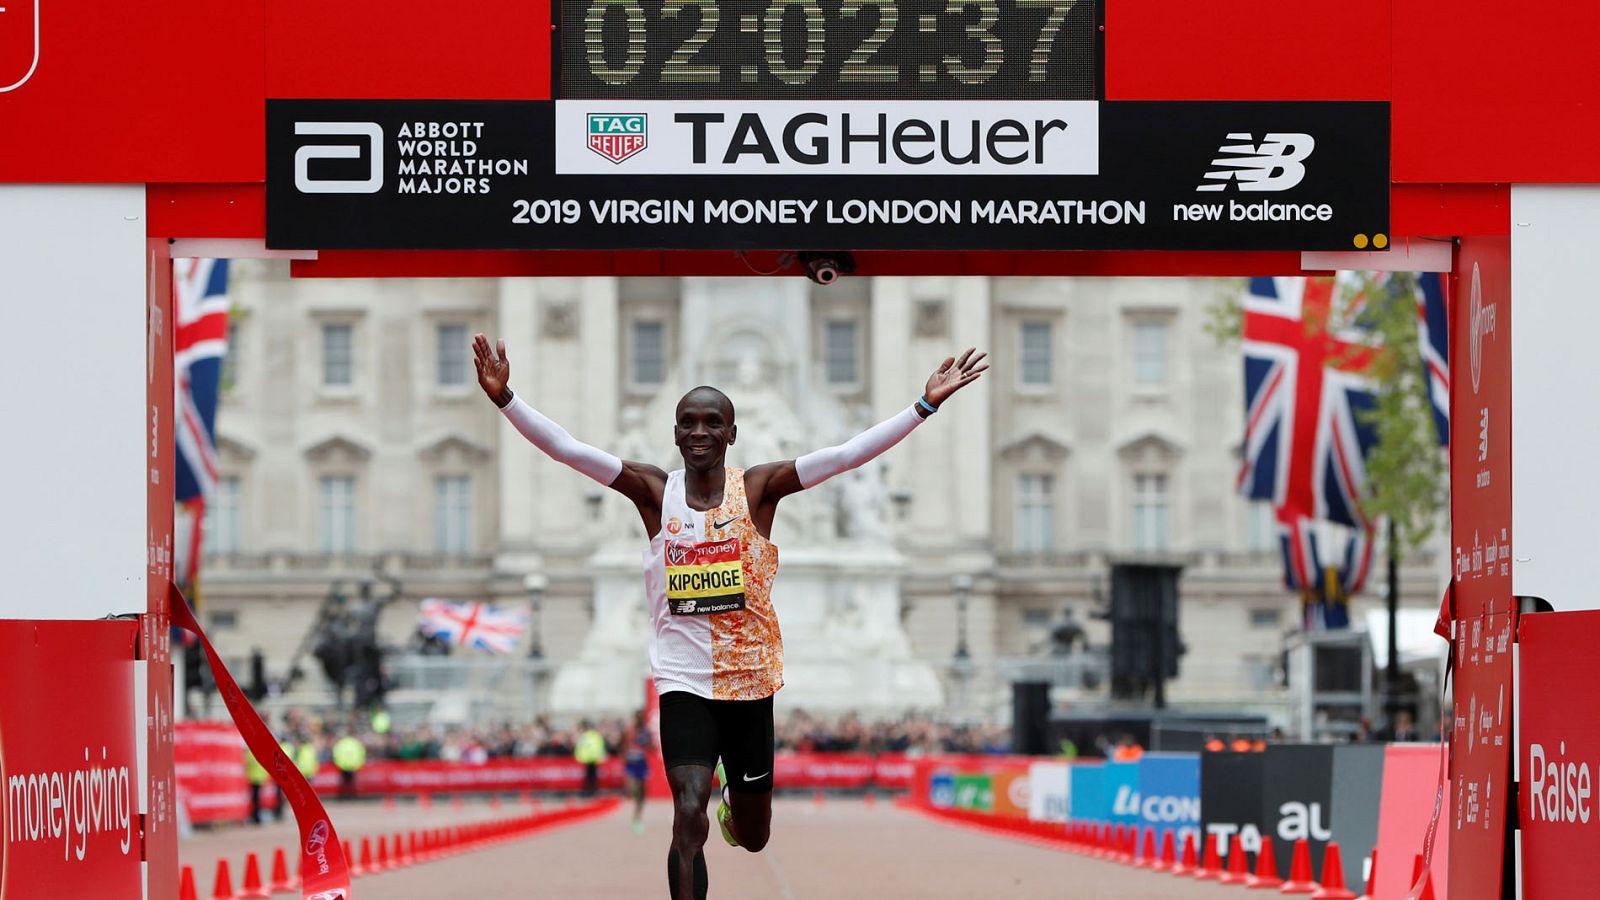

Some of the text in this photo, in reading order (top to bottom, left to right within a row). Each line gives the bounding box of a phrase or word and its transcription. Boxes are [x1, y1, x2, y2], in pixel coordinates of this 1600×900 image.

[585, 0, 1076, 84] 02:02:37
[398, 122, 485, 139] ABBOTT
[593, 118, 641, 132] TAG
[398, 140, 477, 157] WORLD
[591, 136, 643, 159] HEUER
[398, 159, 528, 175] MARATHON
[398, 177, 491, 194] MAJORS
[512, 200, 1146, 225] 2019 VIRGIN MONEY LONDON MARATHON
[1173, 200, 1333, 222] new balance
[697, 543, 737, 556] money
[669, 569, 741, 592] KIPCHOGE
[1530, 740, 1591, 824] Raise
[9, 746, 130, 861] moneygiving
